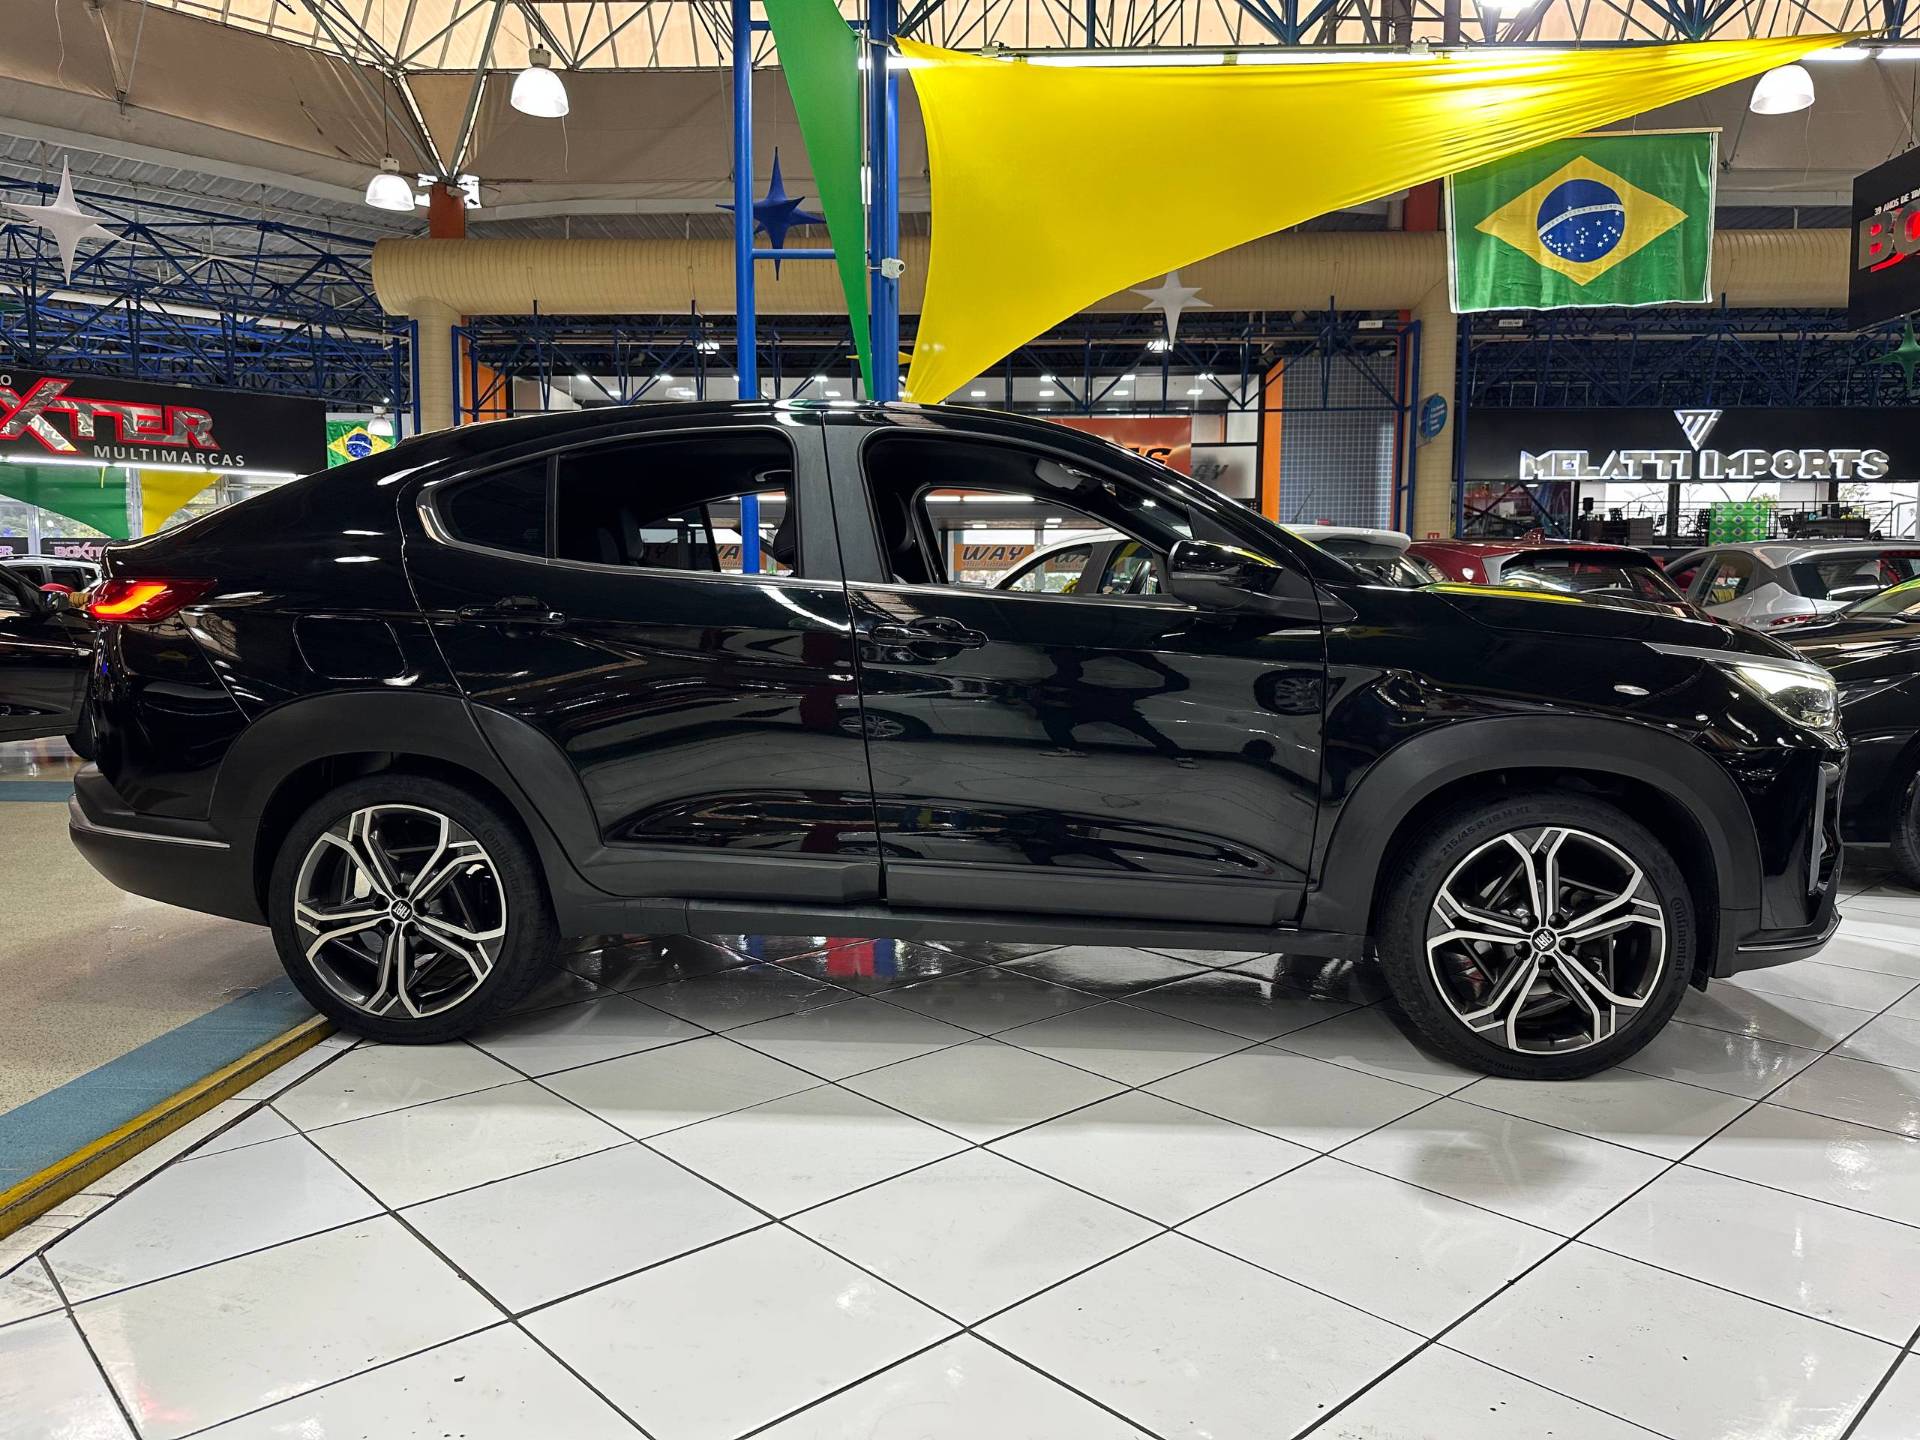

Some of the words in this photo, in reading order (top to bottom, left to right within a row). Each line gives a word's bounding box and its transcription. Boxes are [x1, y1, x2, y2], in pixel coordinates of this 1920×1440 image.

[93, 444, 246, 468] MULTIMARCAS
[1520, 450, 1692, 480] MELATTI
[1700, 449, 1889, 480] IMPORTS
[963, 546, 1024, 560] WAY
[392, 901, 411, 919] FIAT
[1534, 930, 1554, 950] FIAT
[1671, 896, 1687, 972] Continental
